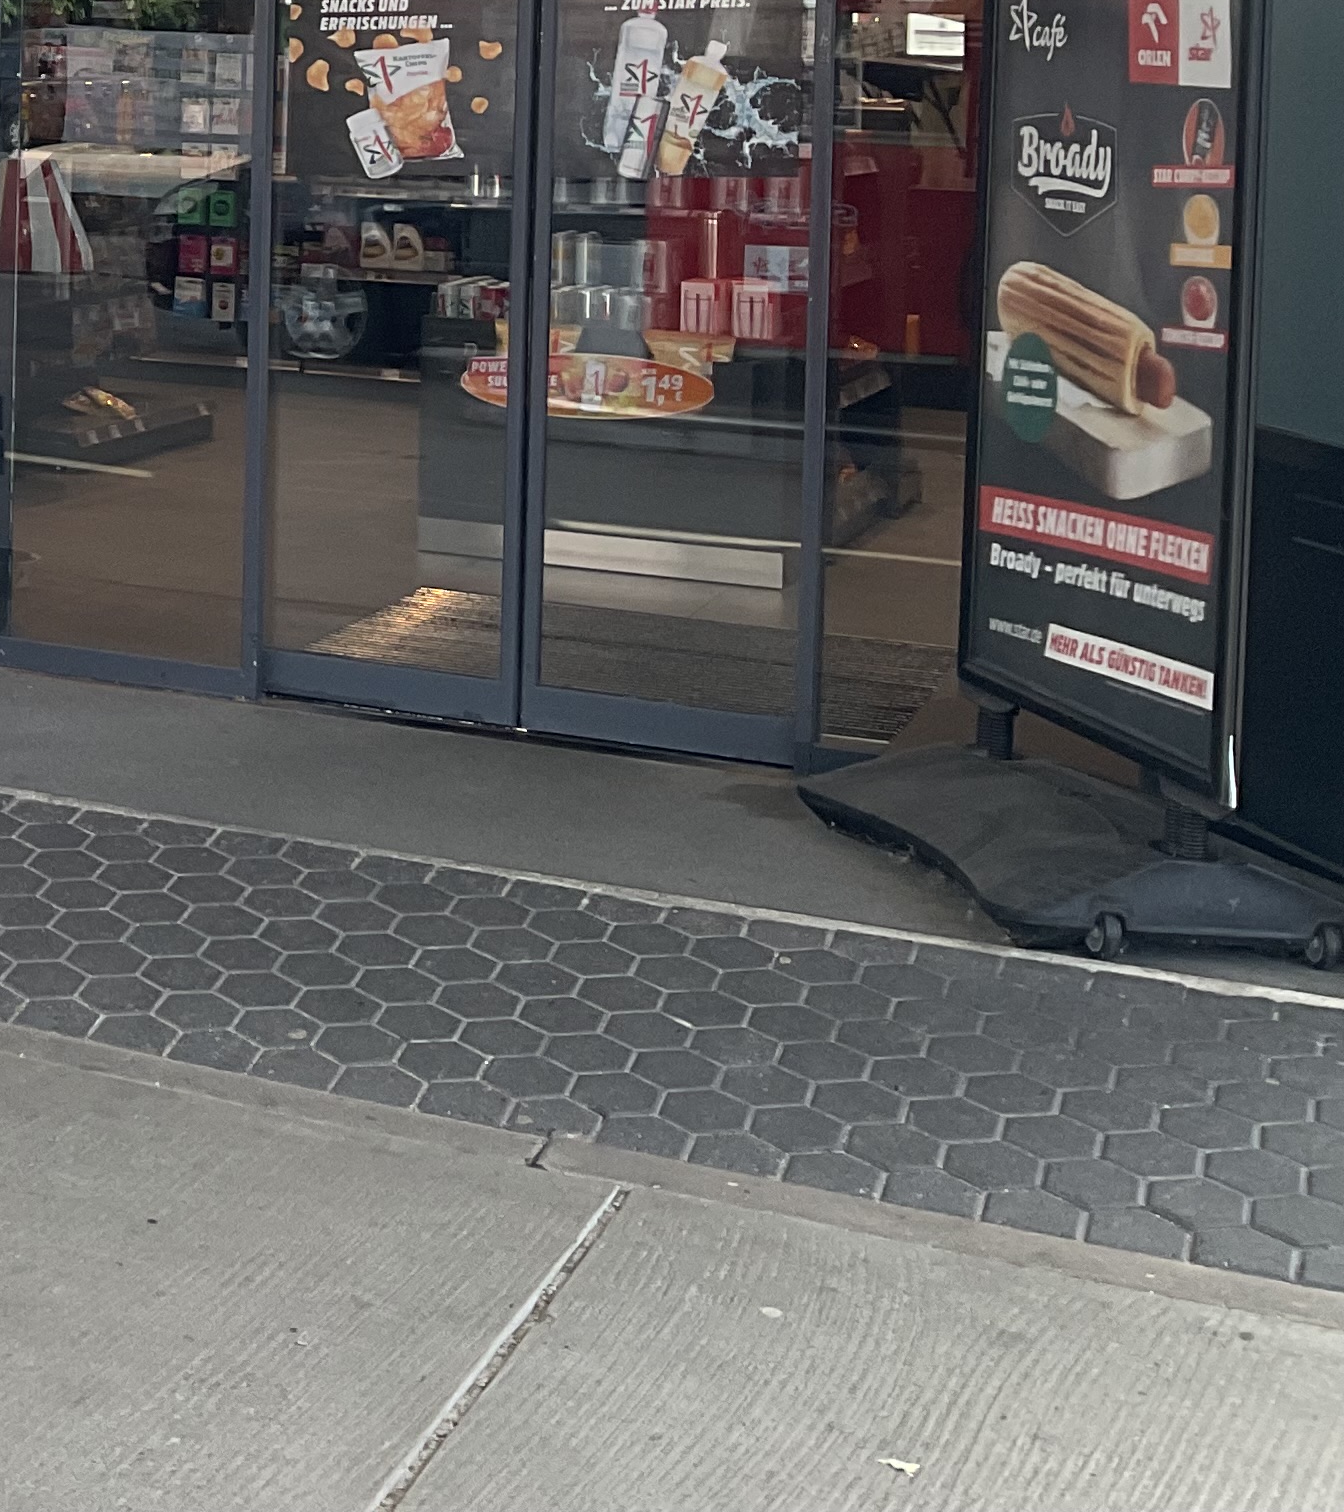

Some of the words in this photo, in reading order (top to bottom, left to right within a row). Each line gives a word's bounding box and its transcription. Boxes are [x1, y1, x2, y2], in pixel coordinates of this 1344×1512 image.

[319, 15, 438, 31] ERFRISCHUNGEN
[1031, 13, 1068, 62] café
[1137, 49, 1171, 67] ORLEN
[1017, 124, 1112, 188] Broady
[991, 496, 1035, 530] HEISS
[1036, 506, 1105, 546] SNACKEN
[1106, 521, 1149, 557] OHNE
[1149, 531, 1211, 573] FLECKEN
[990, 542, 1042, 579] Broady
[1054, 561, 1107, 594] perfekt
[1109, 571, 1131, 599] für
[1132, 583, 1206, 623] unterwegs
[1049, 632, 1079, 658] MEHR
[1079, 641, 1105, 666] ALS
[1107, 648, 1157, 682] GÜNSTIG
